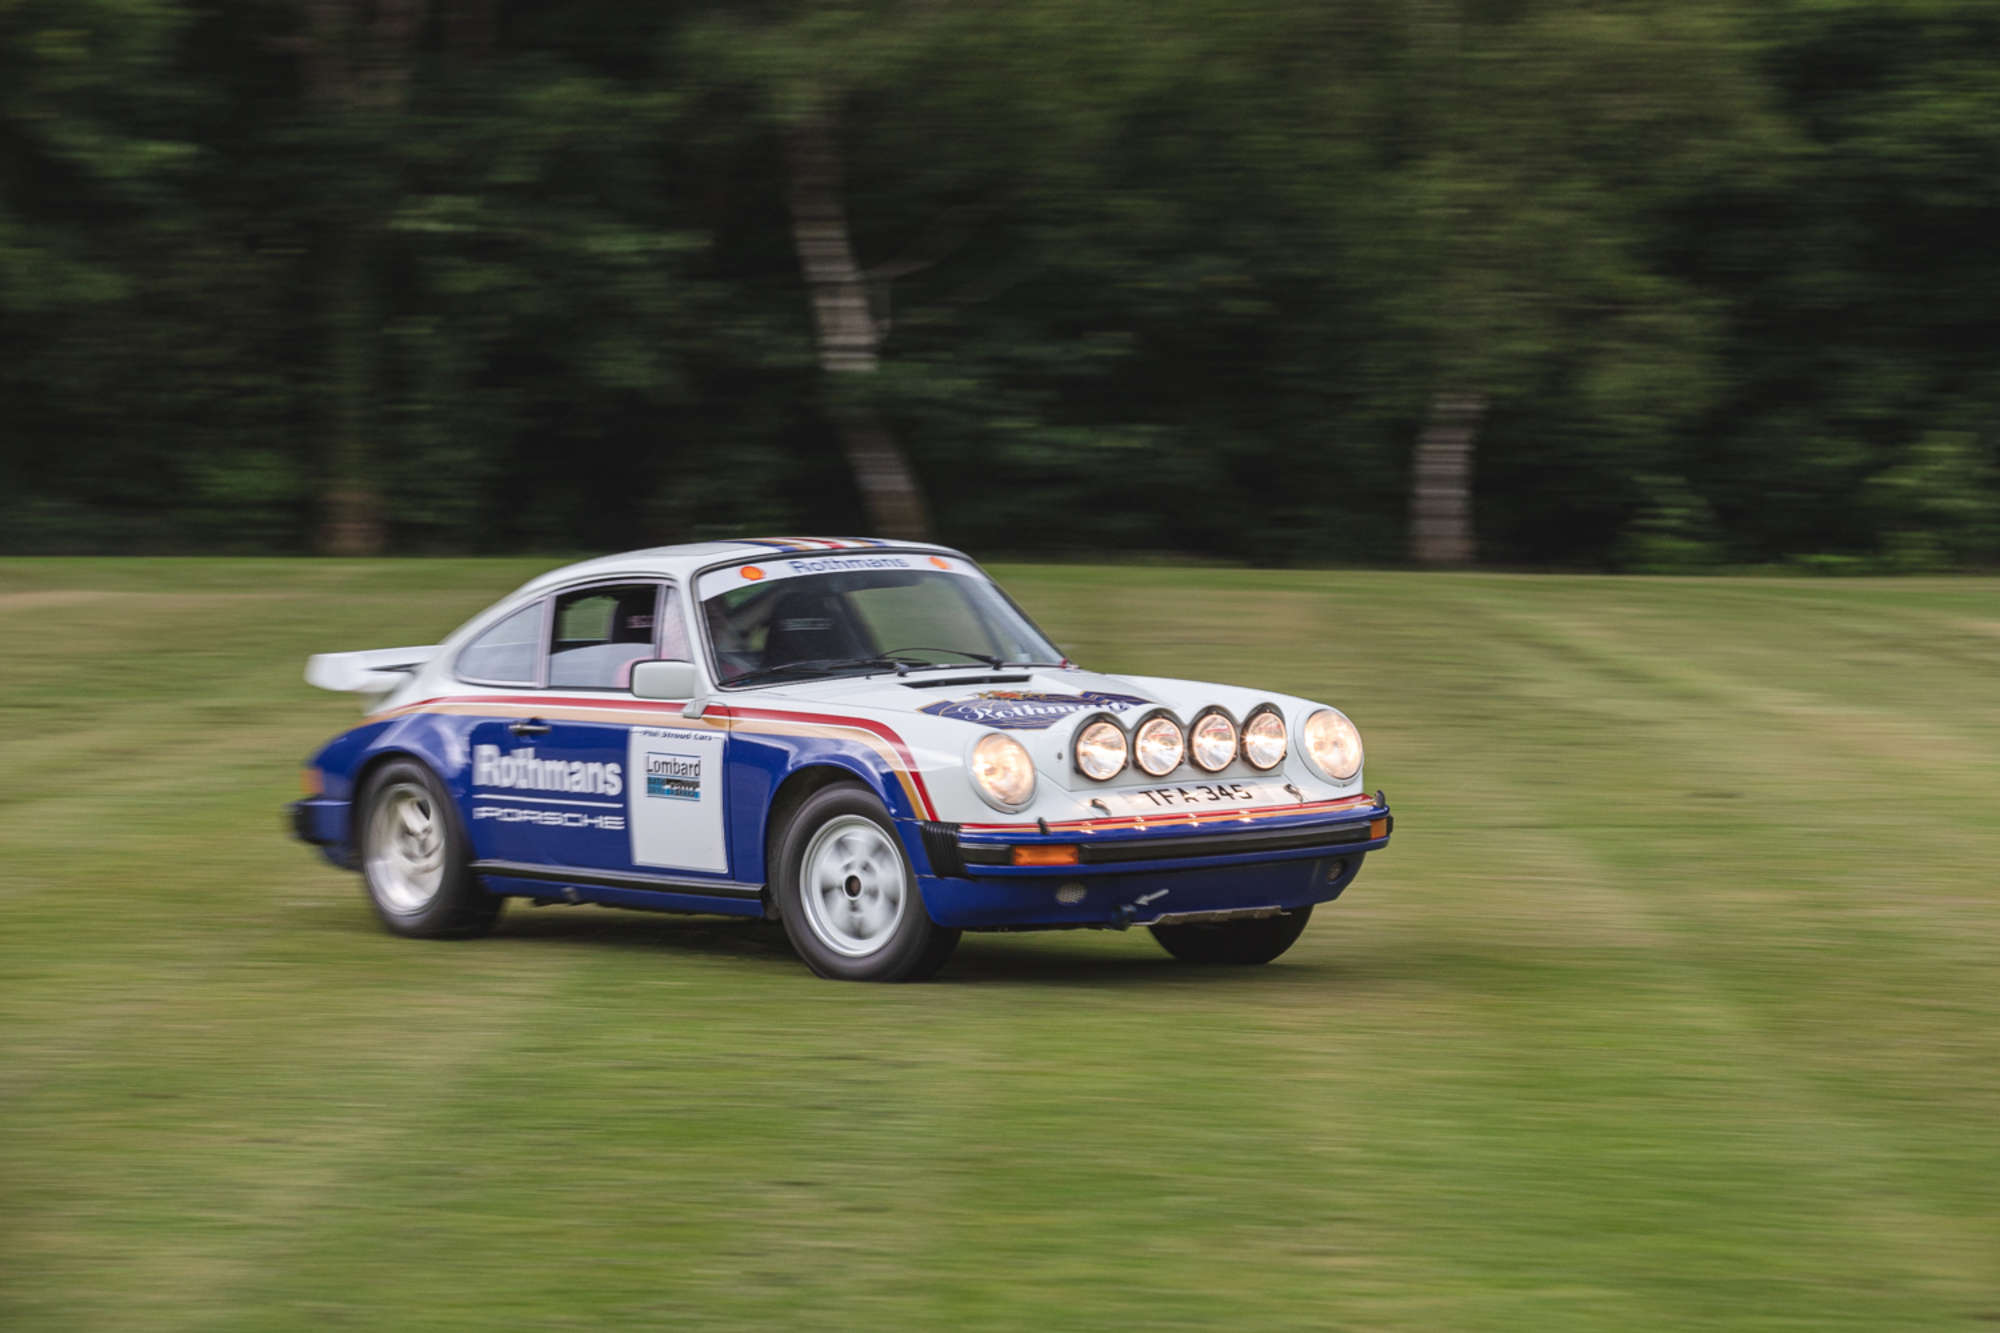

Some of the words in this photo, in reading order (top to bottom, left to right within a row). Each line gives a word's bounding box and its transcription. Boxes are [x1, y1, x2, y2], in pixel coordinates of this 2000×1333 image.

[789, 558, 910, 574] Rothmans
[472, 744, 623, 796] Rothmans
[646, 756, 701, 776] Lombard
[1138, 787, 1200, 806] TFA
[1196, 784, 1253, 802] 345
[472, 806, 625, 830] PORSCHE
